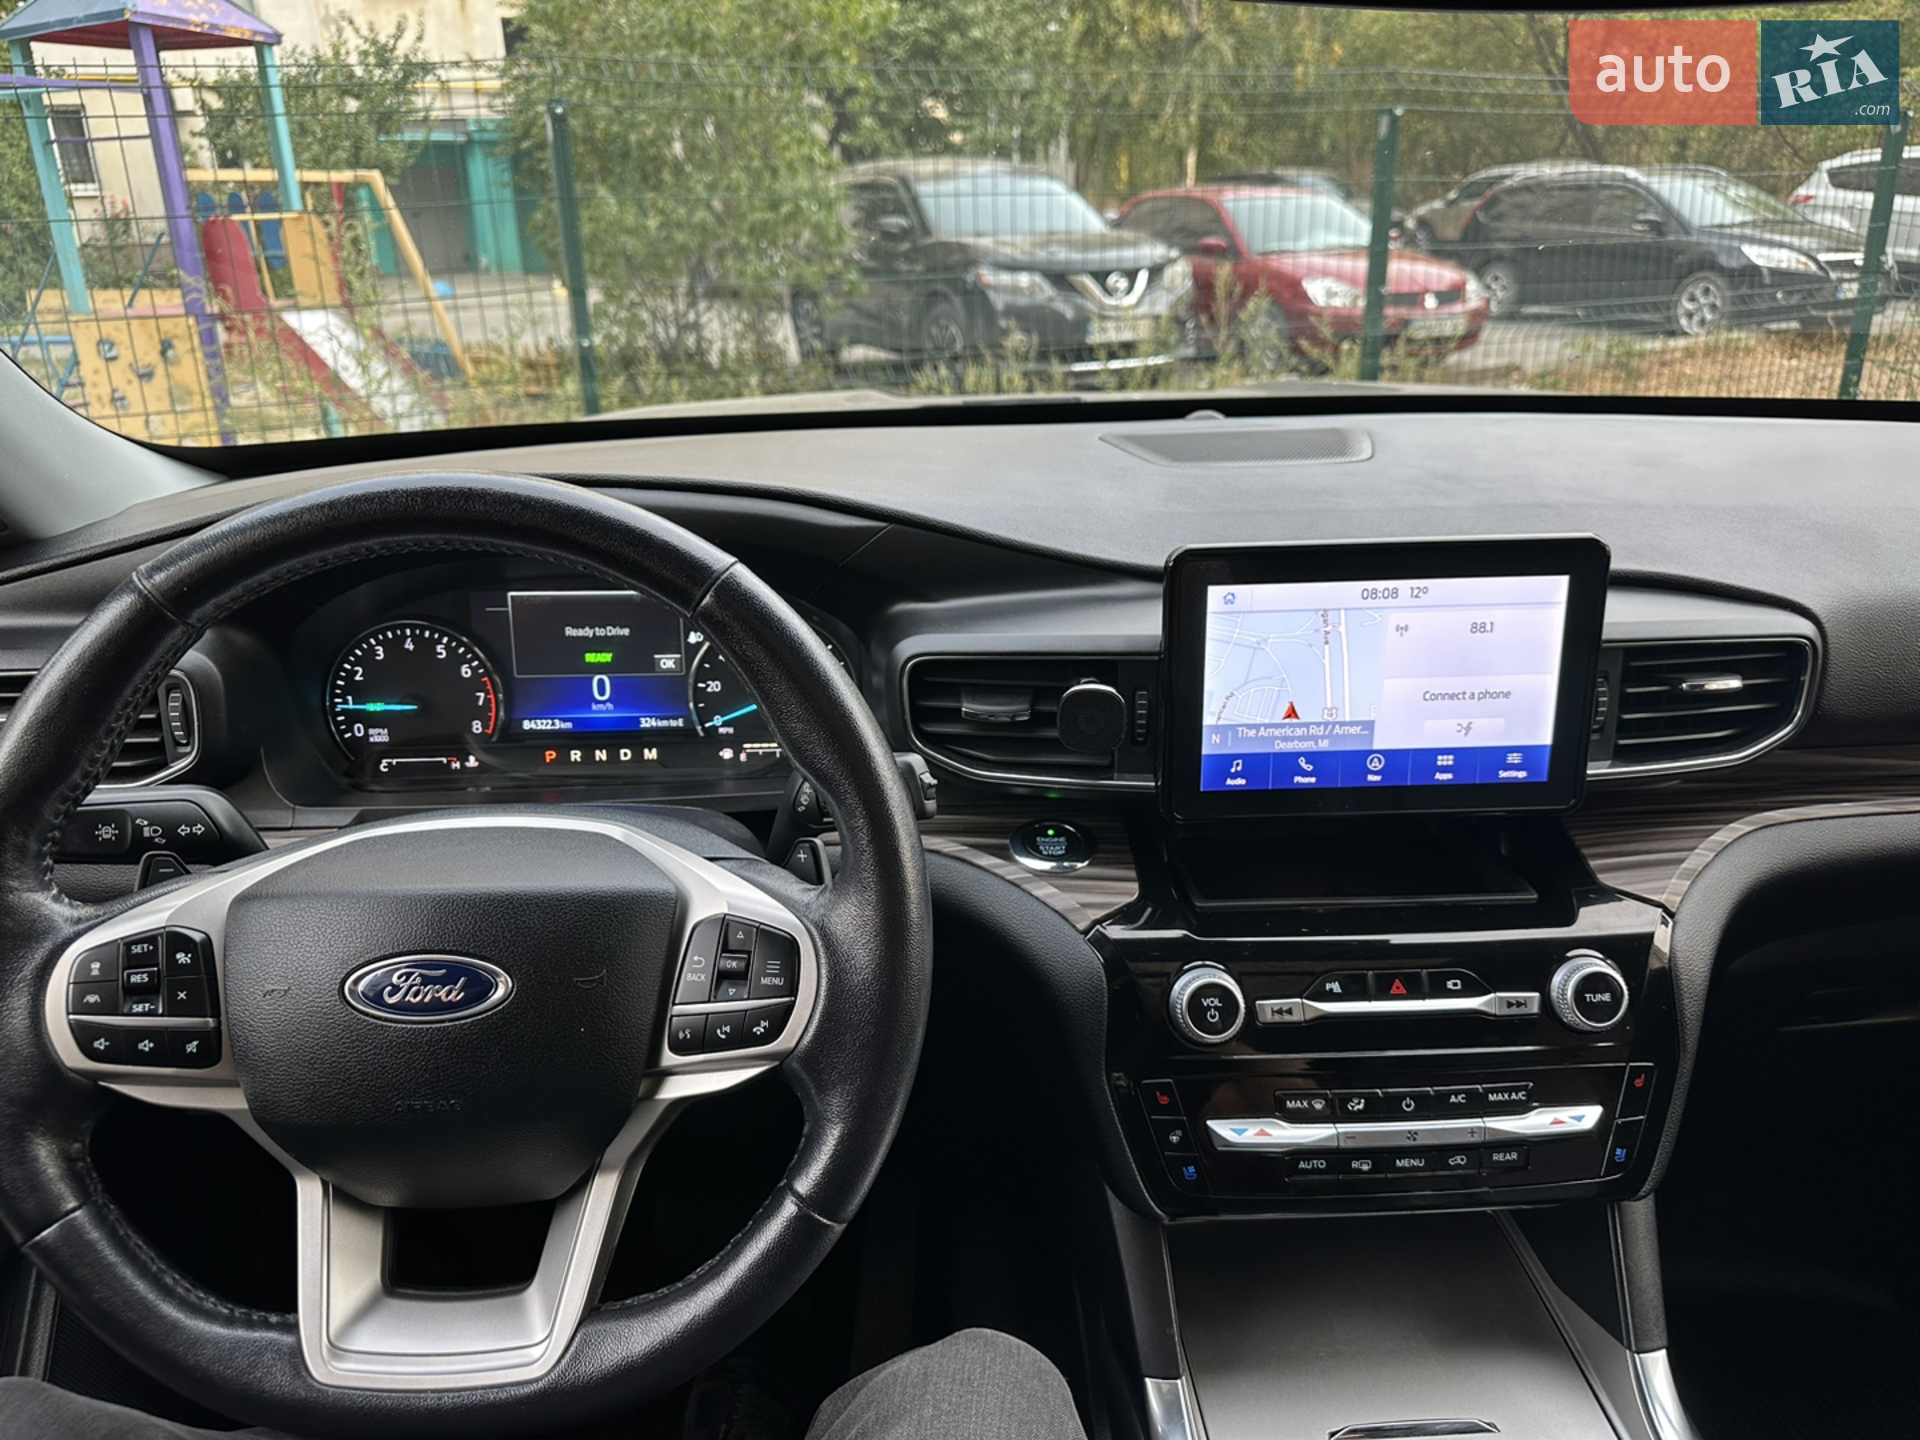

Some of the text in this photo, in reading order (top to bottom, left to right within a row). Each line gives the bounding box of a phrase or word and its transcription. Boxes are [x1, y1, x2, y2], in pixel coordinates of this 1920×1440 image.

[1361, 587, 1399, 600] 08:08
[564, 626, 631, 639] Ready to Drive
[1470, 621, 1494, 635] 88.1
[404, 637, 415, 652] 4
[374, 645, 385, 660] 3
[435, 644, 447, 659] 5
[584, 652, 613, 663] READY
[659, 658, 676, 669] OK
[353, 666, 364, 681] 2
[460, 664, 472, 678] 6
[591, 674, 612, 701] 0
[706, 680, 722, 693] 20
[475, 692, 486, 706] 7
[1422, 688, 1512, 702] Connect a phone
[346, 695, 353, 709] 1
[591, 702, 614, 711] km/h
[471, 720, 482, 734] 8
[522, 719, 573, 730] 84322.3 km
[639, 717, 684, 728] 324 km to E
[353, 723, 364, 737] 0
[368, 728, 388, 736] RPM
[718, 726, 734, 735] MPH
[1237, 726, 1257, 738] The
[1258, 725, 1307, 738] American
[1309, 724, 1323, 736] Rd
[1324, 724, 1330, 736] /
[1211, 733, 1220, 744] N
[1274, 738, 1329, 750] Dearborn, MI
[545, 748, 658, 763] P R N D M
[1293, 775, 1317, 785] Phone
[1367, 774, 1382, 782] Nav
[1434, 771, 1454, 781] Apps
[1498, 769, 1528, 780] Settings
[1225, 777, 1247, 786] Audio
[725, 959, 738, 969] OK
[130, 973, 149, 984] RES
[686, 973, 707, 982] BACK
[760, 976, 785, 986] MENU
[383, 967, 468, 1005] Ford
[1201, 997, 1223, 1007] VOL
[1584, 992, 1612, 1003] TUNE
[1449, 1093, 1467, 1104] A/C
[1488, 1091, 1527, 1102] MAX A/C
[1286, 1099, 1309, 1110] MAX
[1492, 1151, 1518, 1162] REAR
[1298, 1159, 1326, 1170] AUTO
[1396, 1157, 1425, 1168] MENU
